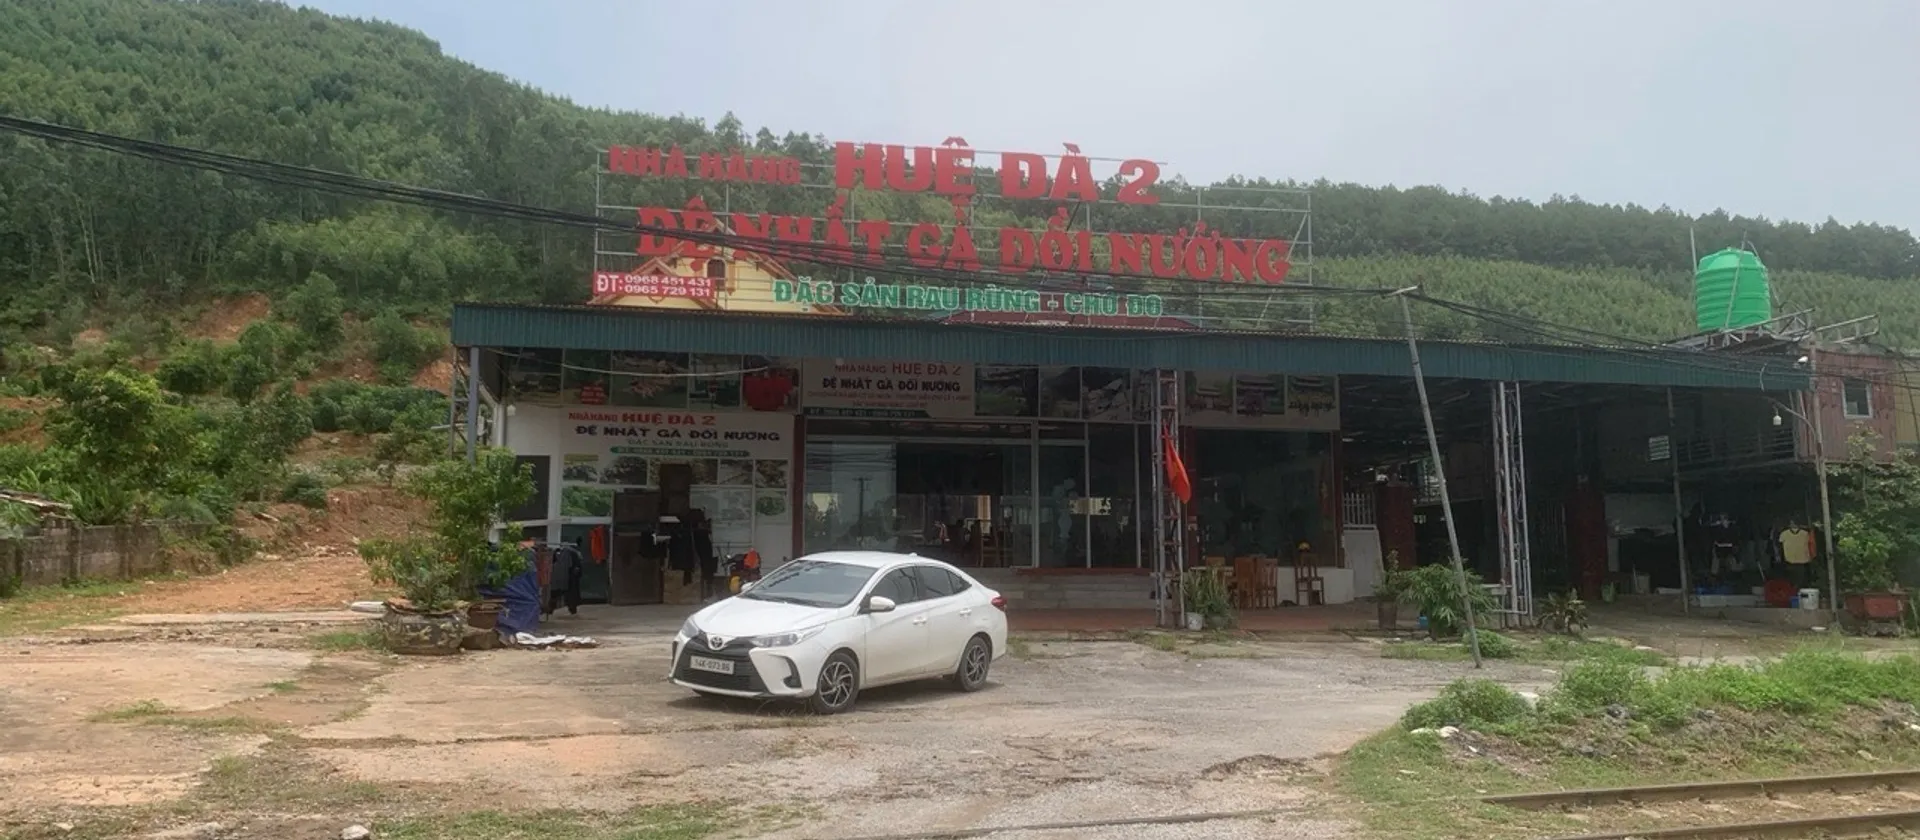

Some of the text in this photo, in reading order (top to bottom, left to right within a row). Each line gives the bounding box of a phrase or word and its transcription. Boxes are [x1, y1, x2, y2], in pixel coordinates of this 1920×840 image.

[608, 143, 689, 177] NHÀ
[700, 147, 801, 184] HÀNG
[1001, 142, 1100, 201] ĐÀ
[1116, 158, 1162, 204] 2
[636, 194, 716, 271] ĐỆ
[731, 193, 892, 267] NHẤT
[908, 206, 983, 271] GÀ
[1108, 219, 1292, 283] NƯỚNG
[597, 274, 711, 292] ĐT: 0968 451 431
[624, 284, 711, 296] 0965 729 131
[773, 276, 834, 312] ĐẶC
[841, 276, 901, 307] SẢN
[905, 285, 960, 310] RAU
[701, 415, 717, 426] 2
